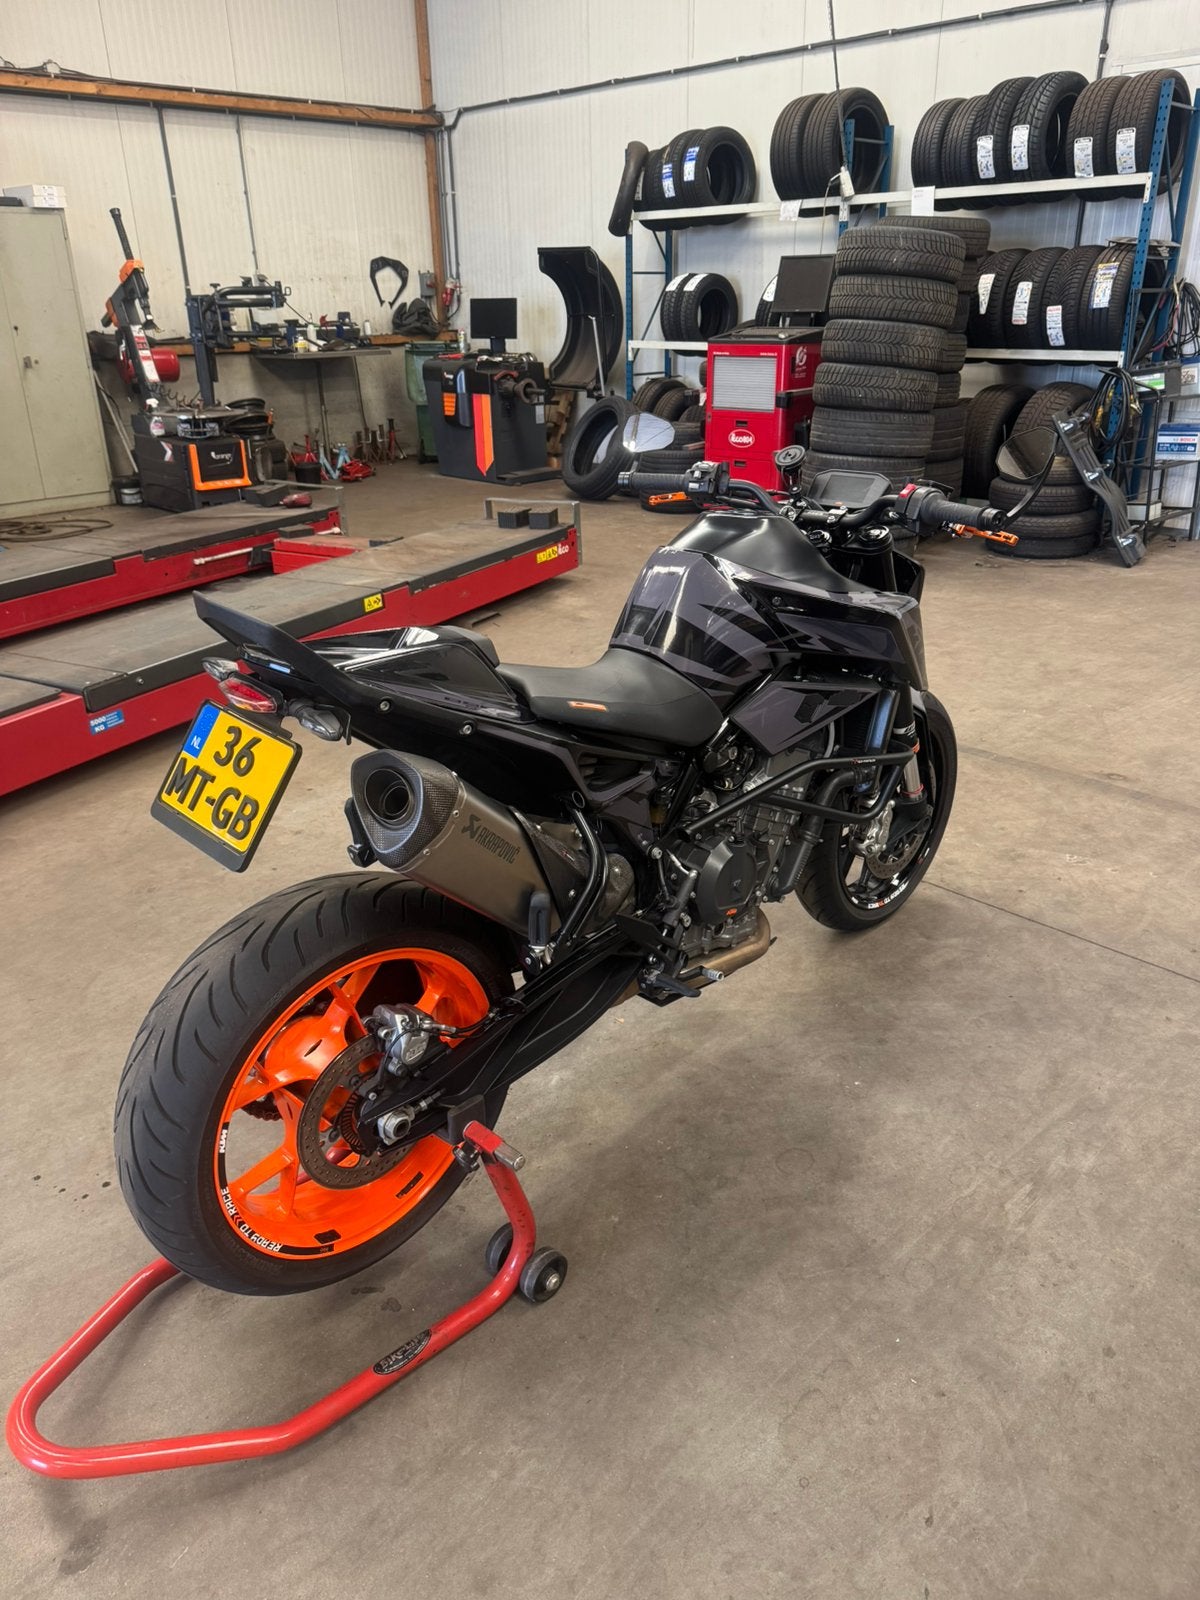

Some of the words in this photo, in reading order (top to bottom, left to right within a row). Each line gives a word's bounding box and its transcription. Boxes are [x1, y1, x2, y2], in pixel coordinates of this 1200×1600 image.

[190, 736, 200, 749] NL
[213, 725, 262, 777] 36
[165, 757, 260, 841] MT-GB
[475, 827, 521, 865] AKRAPOVIČ
[219, 1129, 228, 1153] KTM
[220, 1186, 238, 1217] RACE
[239, 1223, 253, 1240] TO
[250, 1234, 283, 1252] READY
